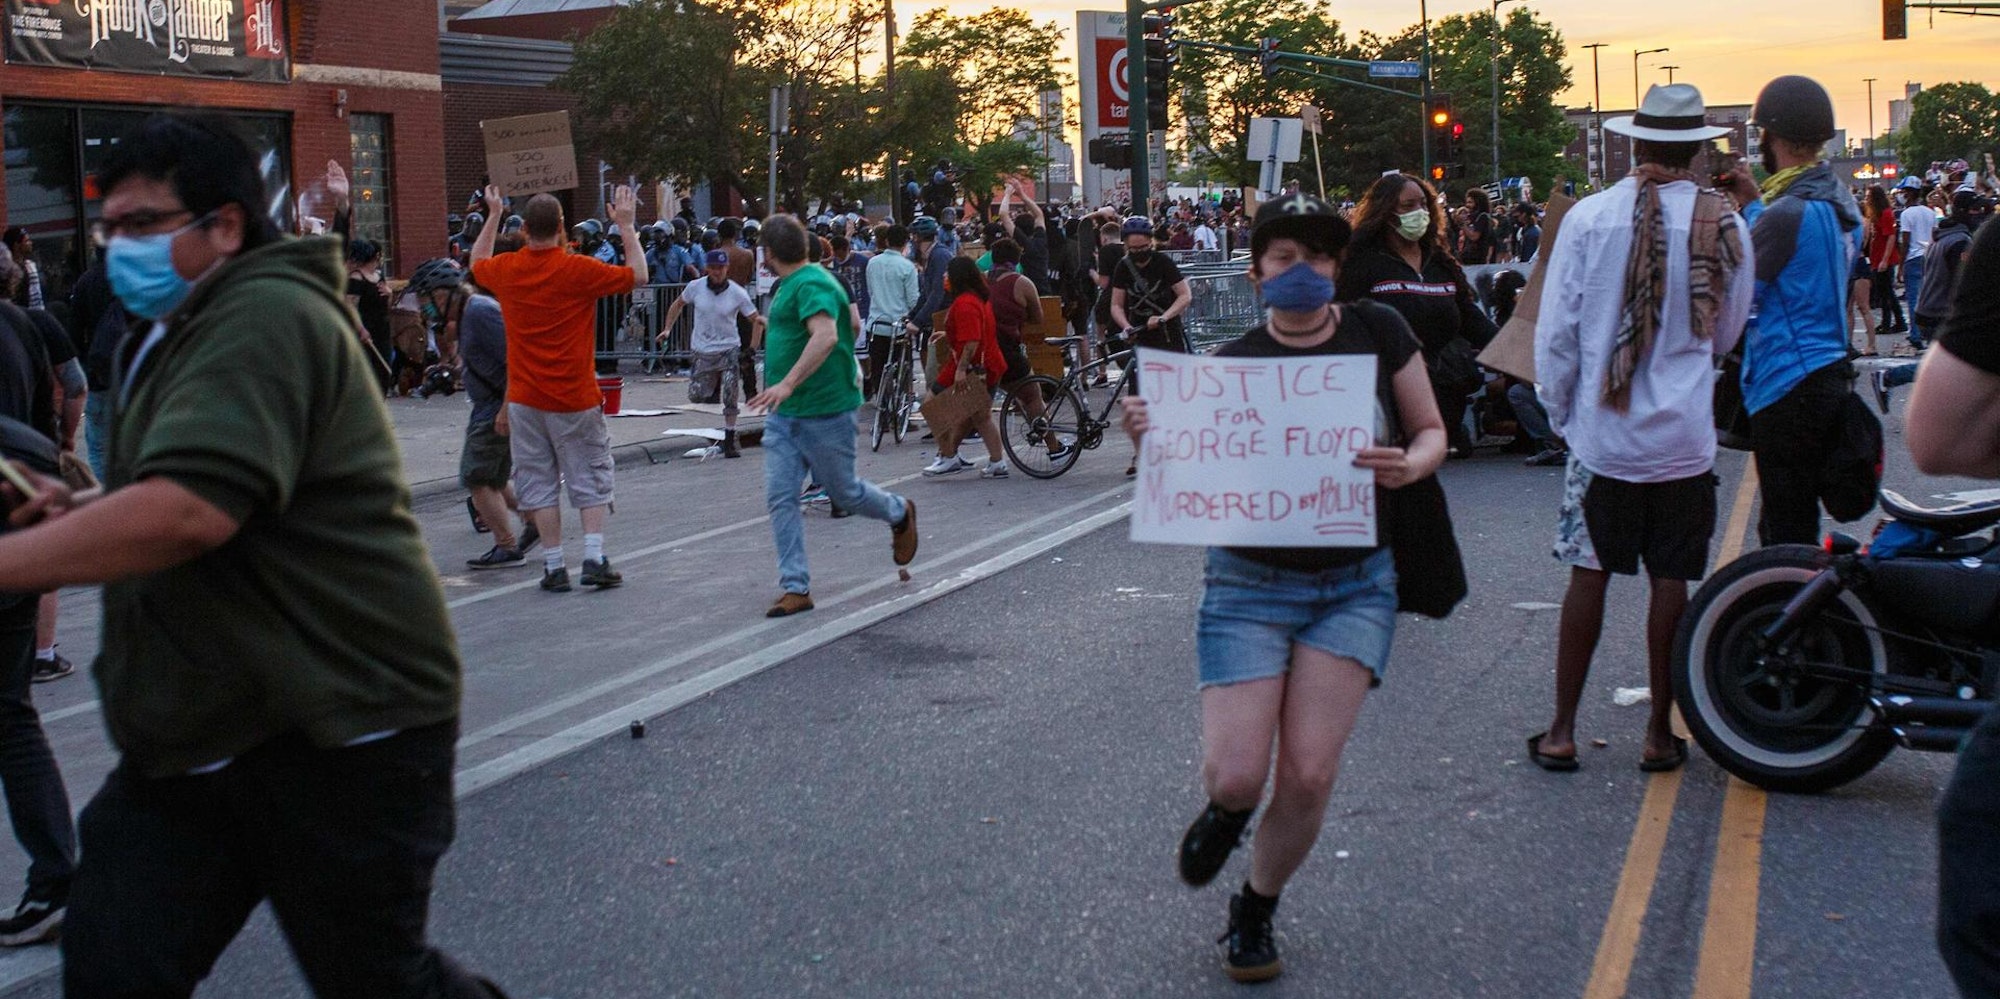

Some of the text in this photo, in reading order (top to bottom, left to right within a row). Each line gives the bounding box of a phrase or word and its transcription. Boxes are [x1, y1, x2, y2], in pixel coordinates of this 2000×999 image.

[11, 14, 62, 31] THE FIREHOUSE
[511, 151, 544, 163] 300
[1144, 361, 1347, 404] JUSTICE
[1214, 408, 1266, 427] FOR
[1146, 425, 1369, 467] GEORGE FLOYD
[1317, 476, 1374, 519] POLICE
